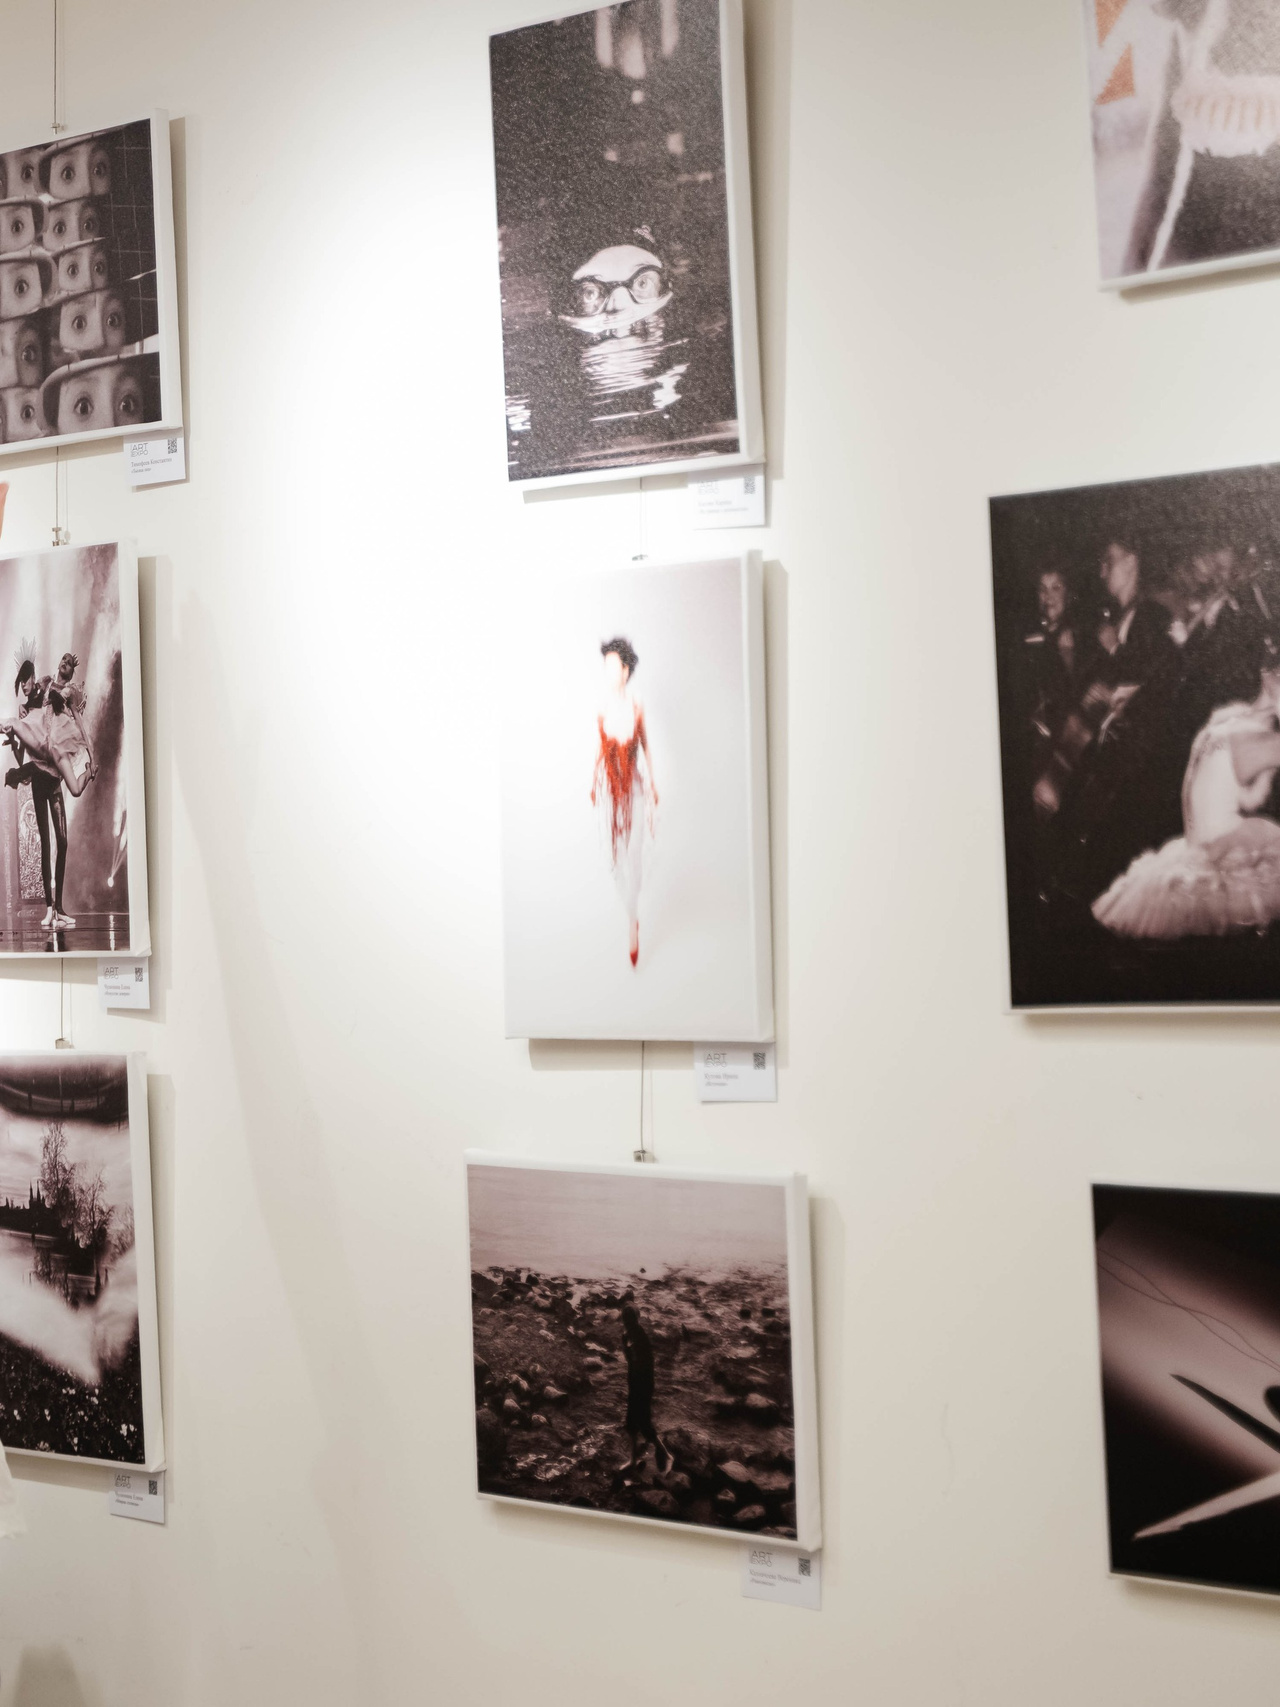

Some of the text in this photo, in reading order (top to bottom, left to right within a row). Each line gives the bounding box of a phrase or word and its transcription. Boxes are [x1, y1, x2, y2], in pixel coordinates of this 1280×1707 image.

[132, 443, 148, 451] ART
[105, 967, 119, 975] ART
[706, 1053, 727, 1061] ART
[704, 1060, 727, 1068] EXPO
[116, 1475, 131, 1484] ART
[752, 1550, 773, 1560] ART
[750, 1558, 773, 1568] EXPO
